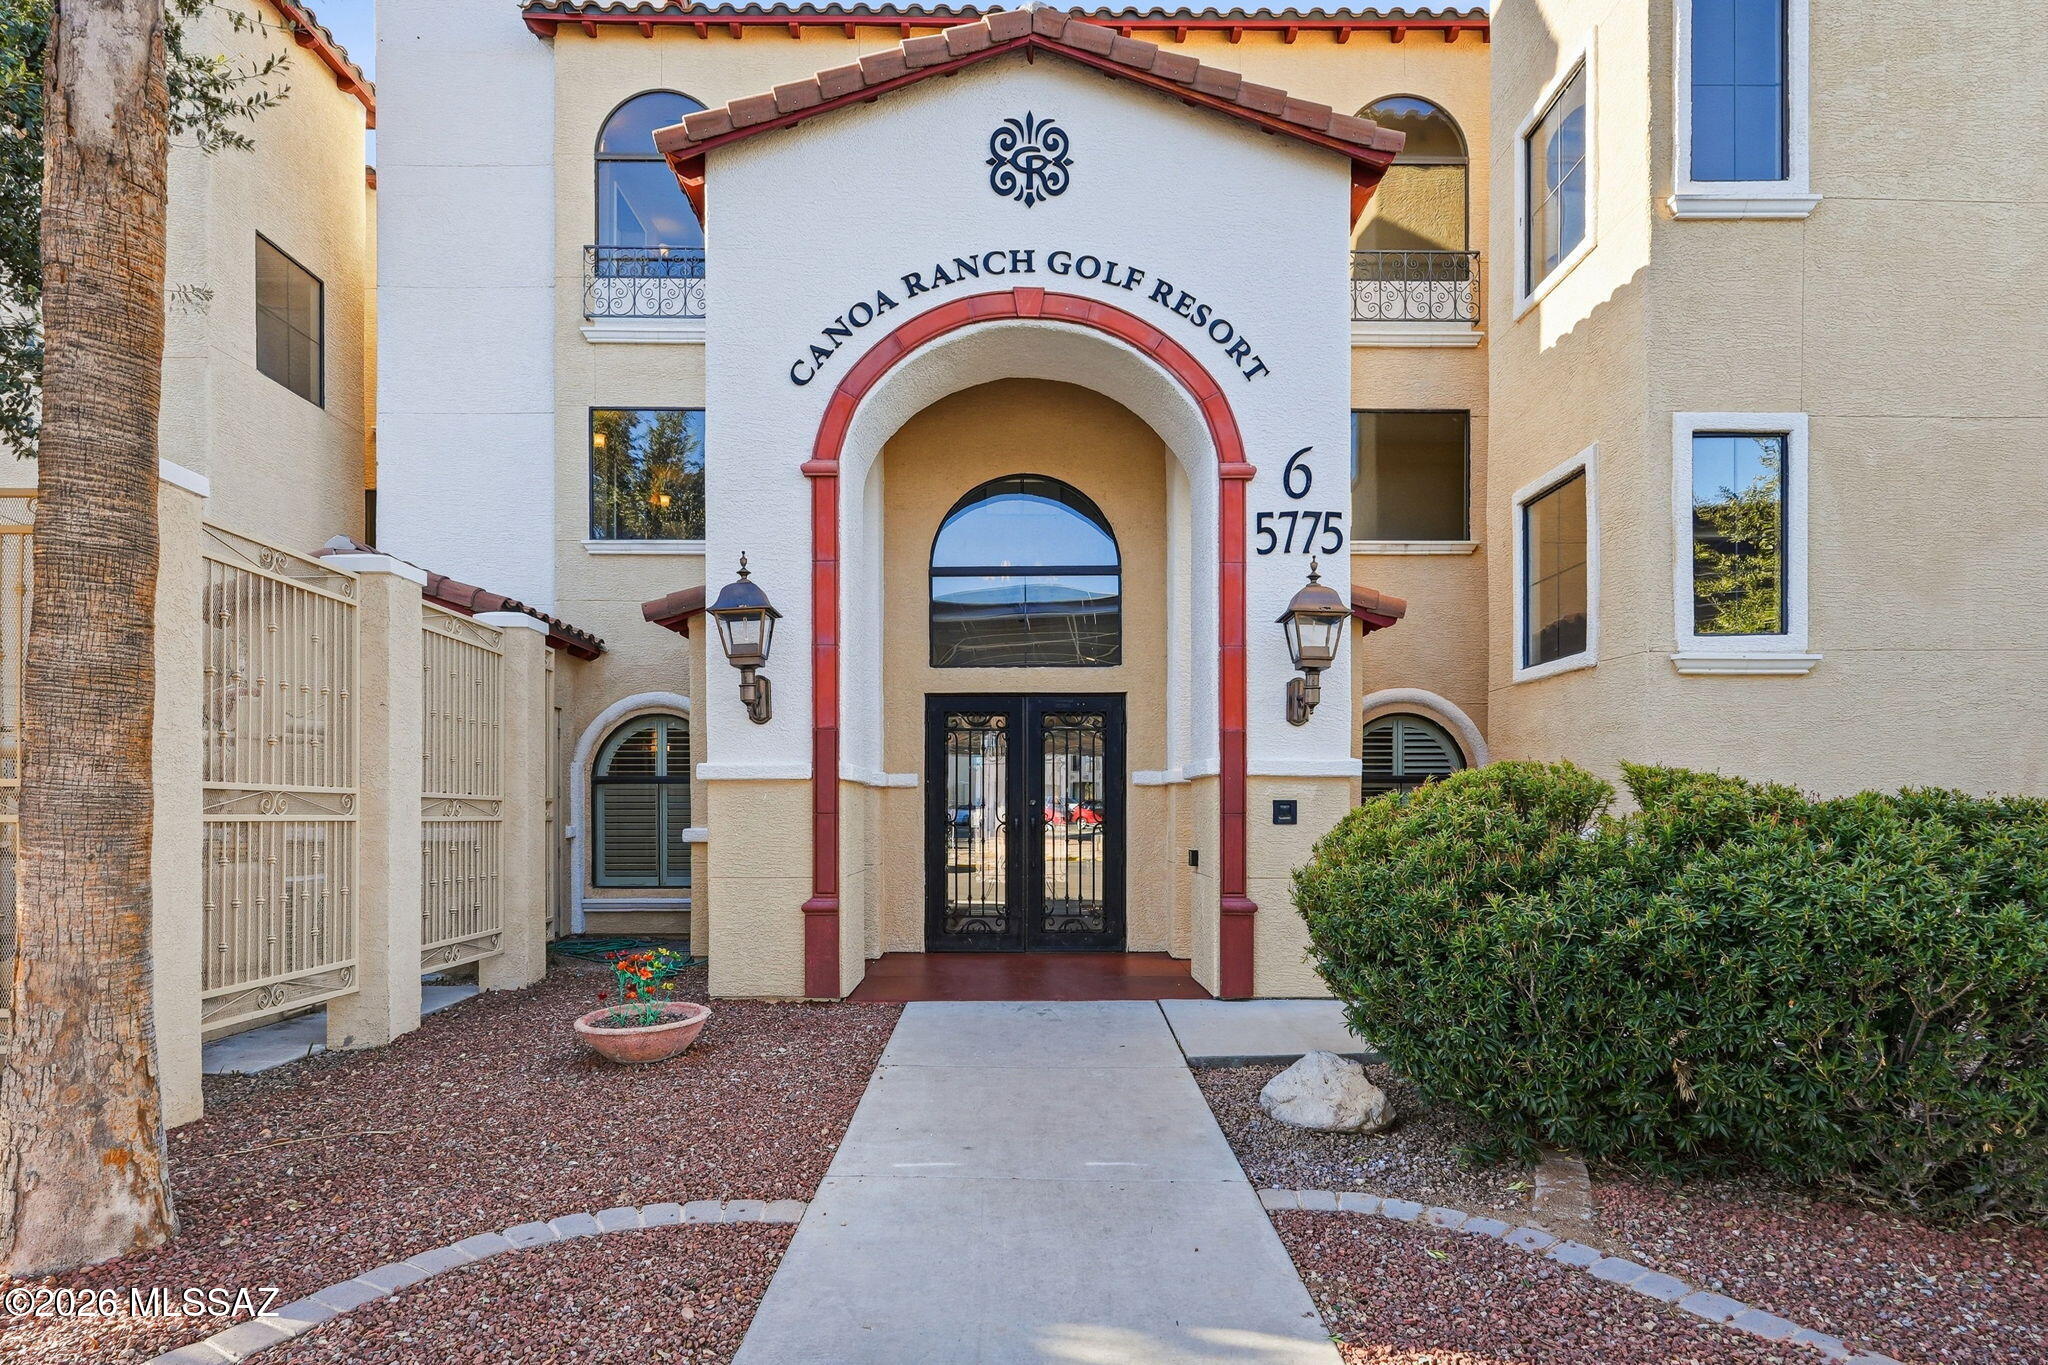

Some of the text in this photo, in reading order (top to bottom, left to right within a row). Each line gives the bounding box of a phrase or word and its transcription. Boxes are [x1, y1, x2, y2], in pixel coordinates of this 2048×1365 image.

[789, 249, 1270, 387] CANOA RANCH GOLF RESORT
[1283, 446, 1313, 499] 6
[1256, 511, 1343, 555] 5775
